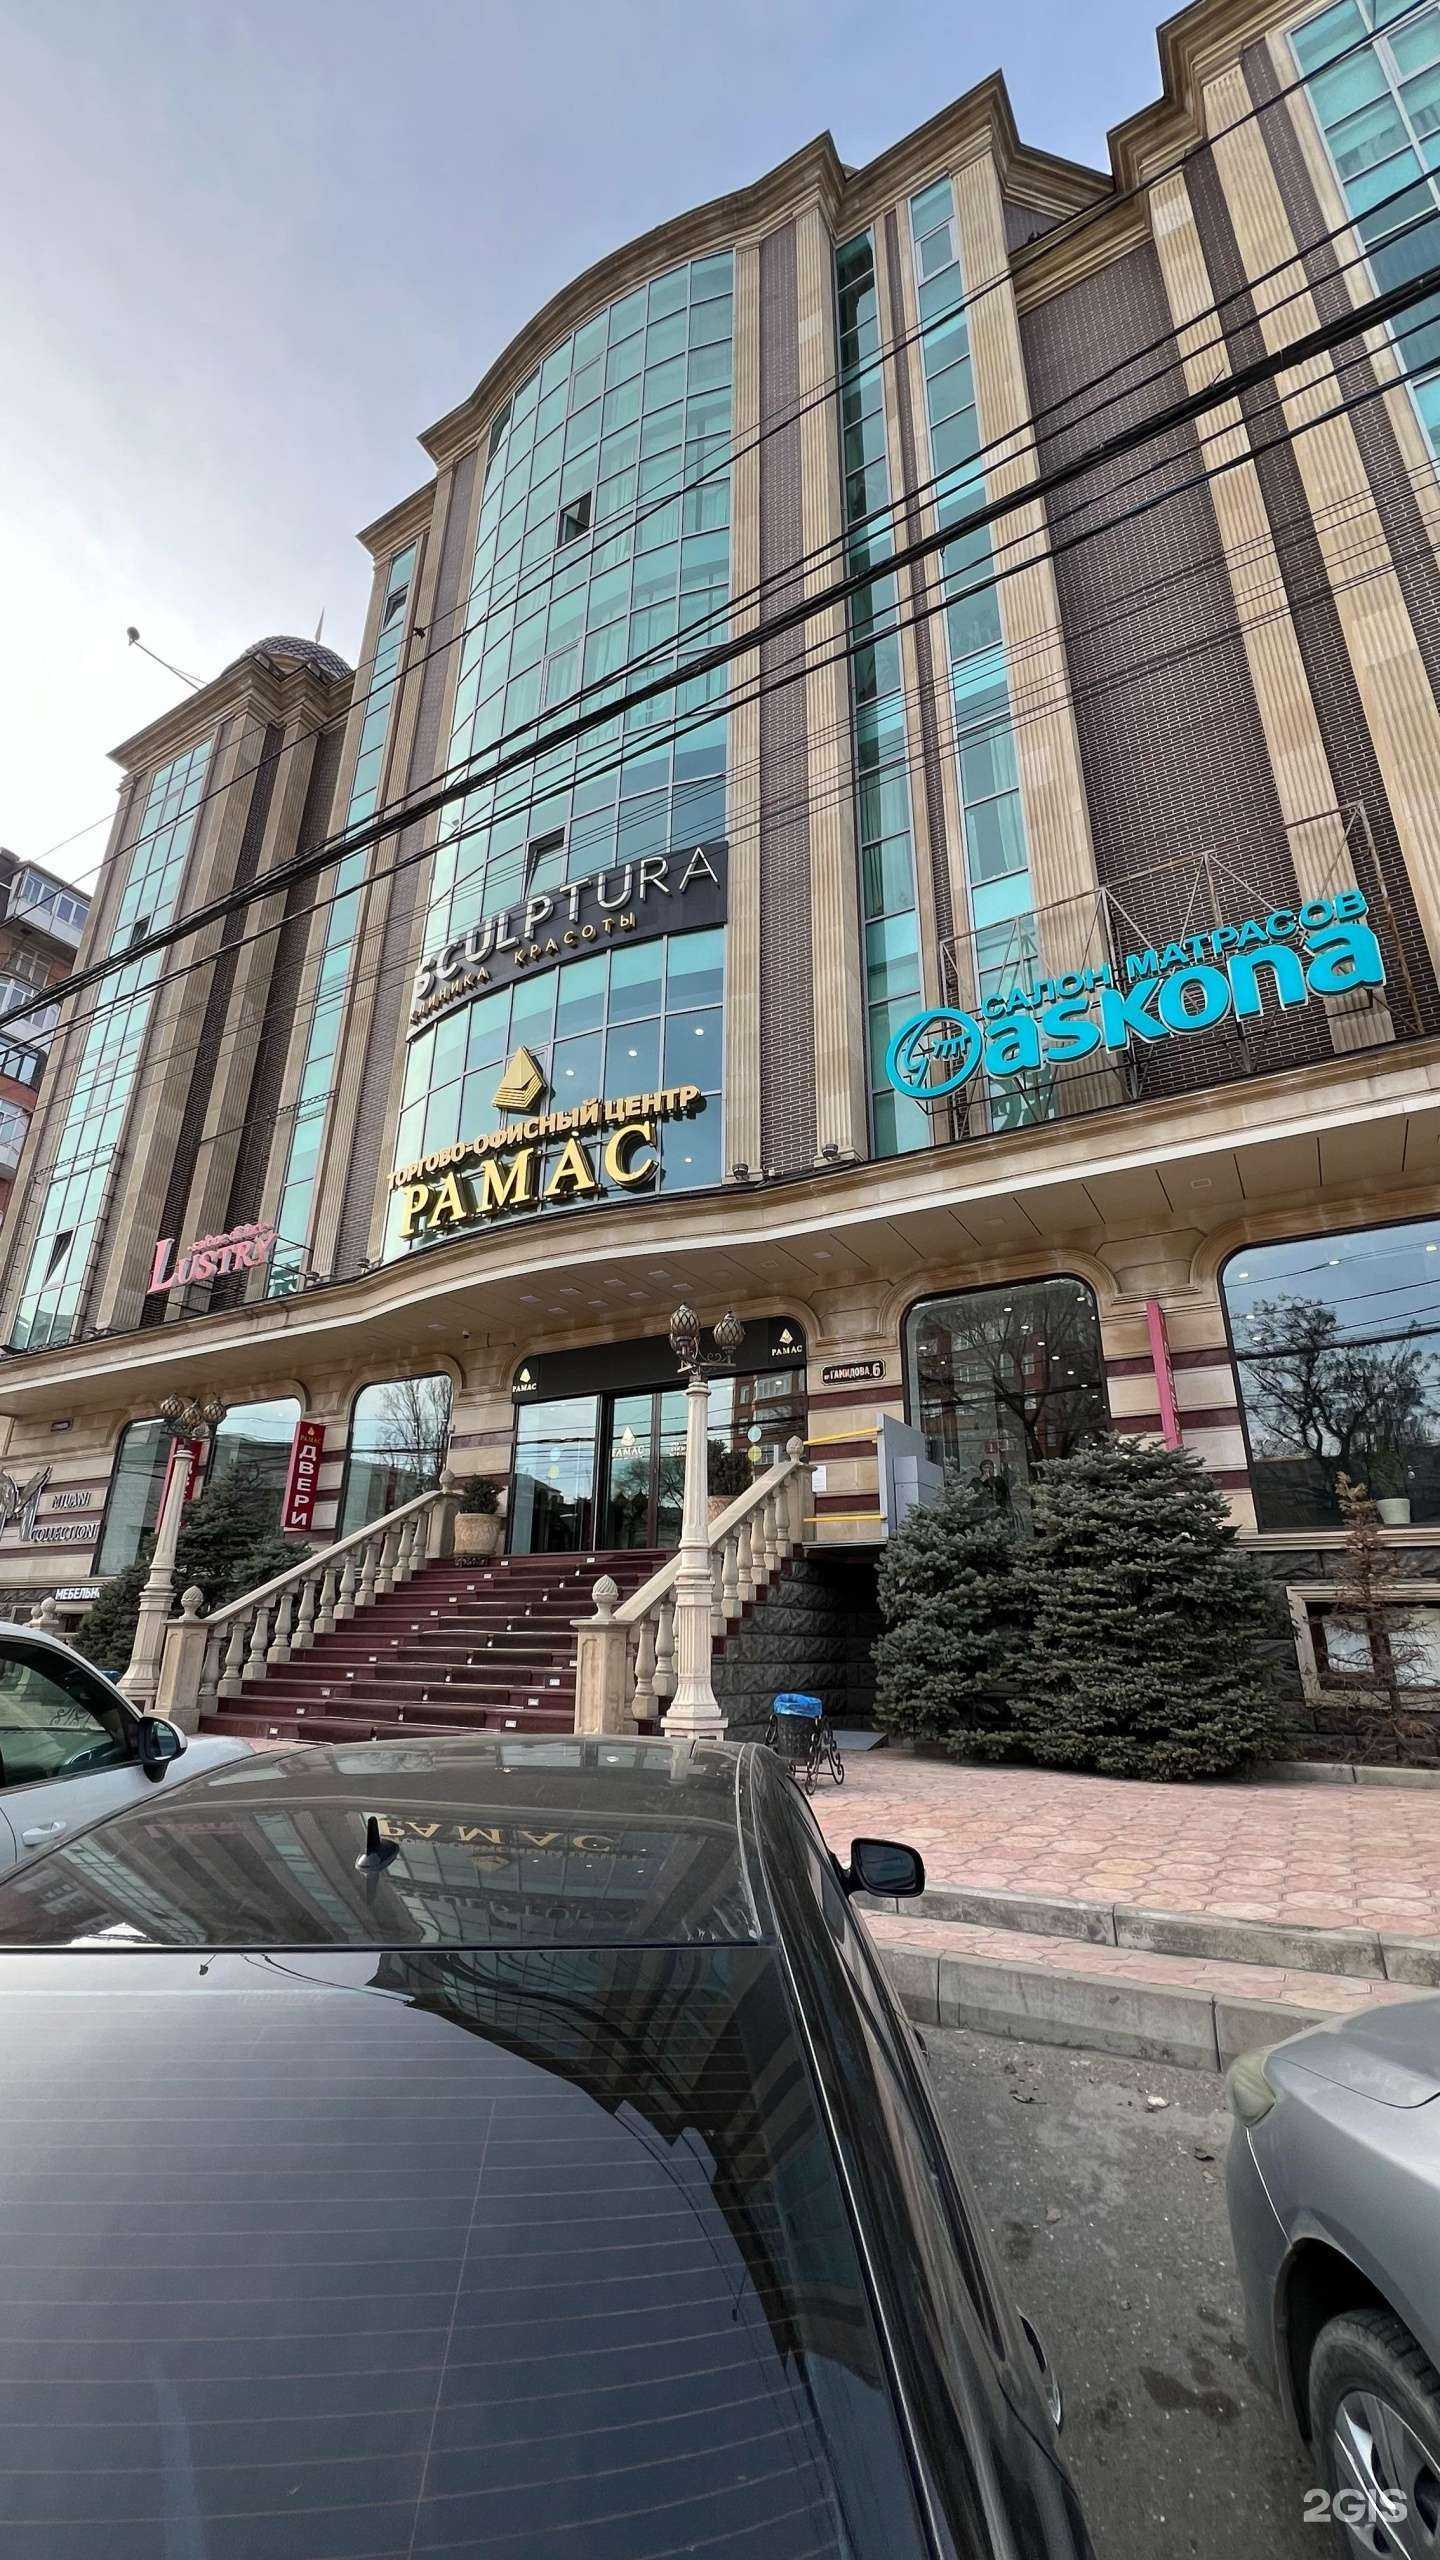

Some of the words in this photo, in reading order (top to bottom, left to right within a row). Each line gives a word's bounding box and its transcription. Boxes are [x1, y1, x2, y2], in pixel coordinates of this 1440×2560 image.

[415, 846, 721, 1000] SCULPTURA
[513, 911, 637, 969] КРАСОТЫ
[982, 962, 1113, 1019] САЛОН
[1126, 888, 1371, 984] МАТРАСОВ
[983, 923, 1387, 1081] askona
[387, 1097, 601, 1192] ТОРГОВО-ОФИСНЫЙ
[604, 1085, 706, 1124] ЦЕНТР
[400, 1121, 661, 1239] РАМАС
[512, 1382, 537, 1392] РАМАС
[771, 1344, 803, 1357] РАМАС
[872, 1362, 881, 1377] 6
[291, 1444, 317, 1526] ДВЕРИ
[54, 1587, 101, 1600] МЕБЕЛЬН
